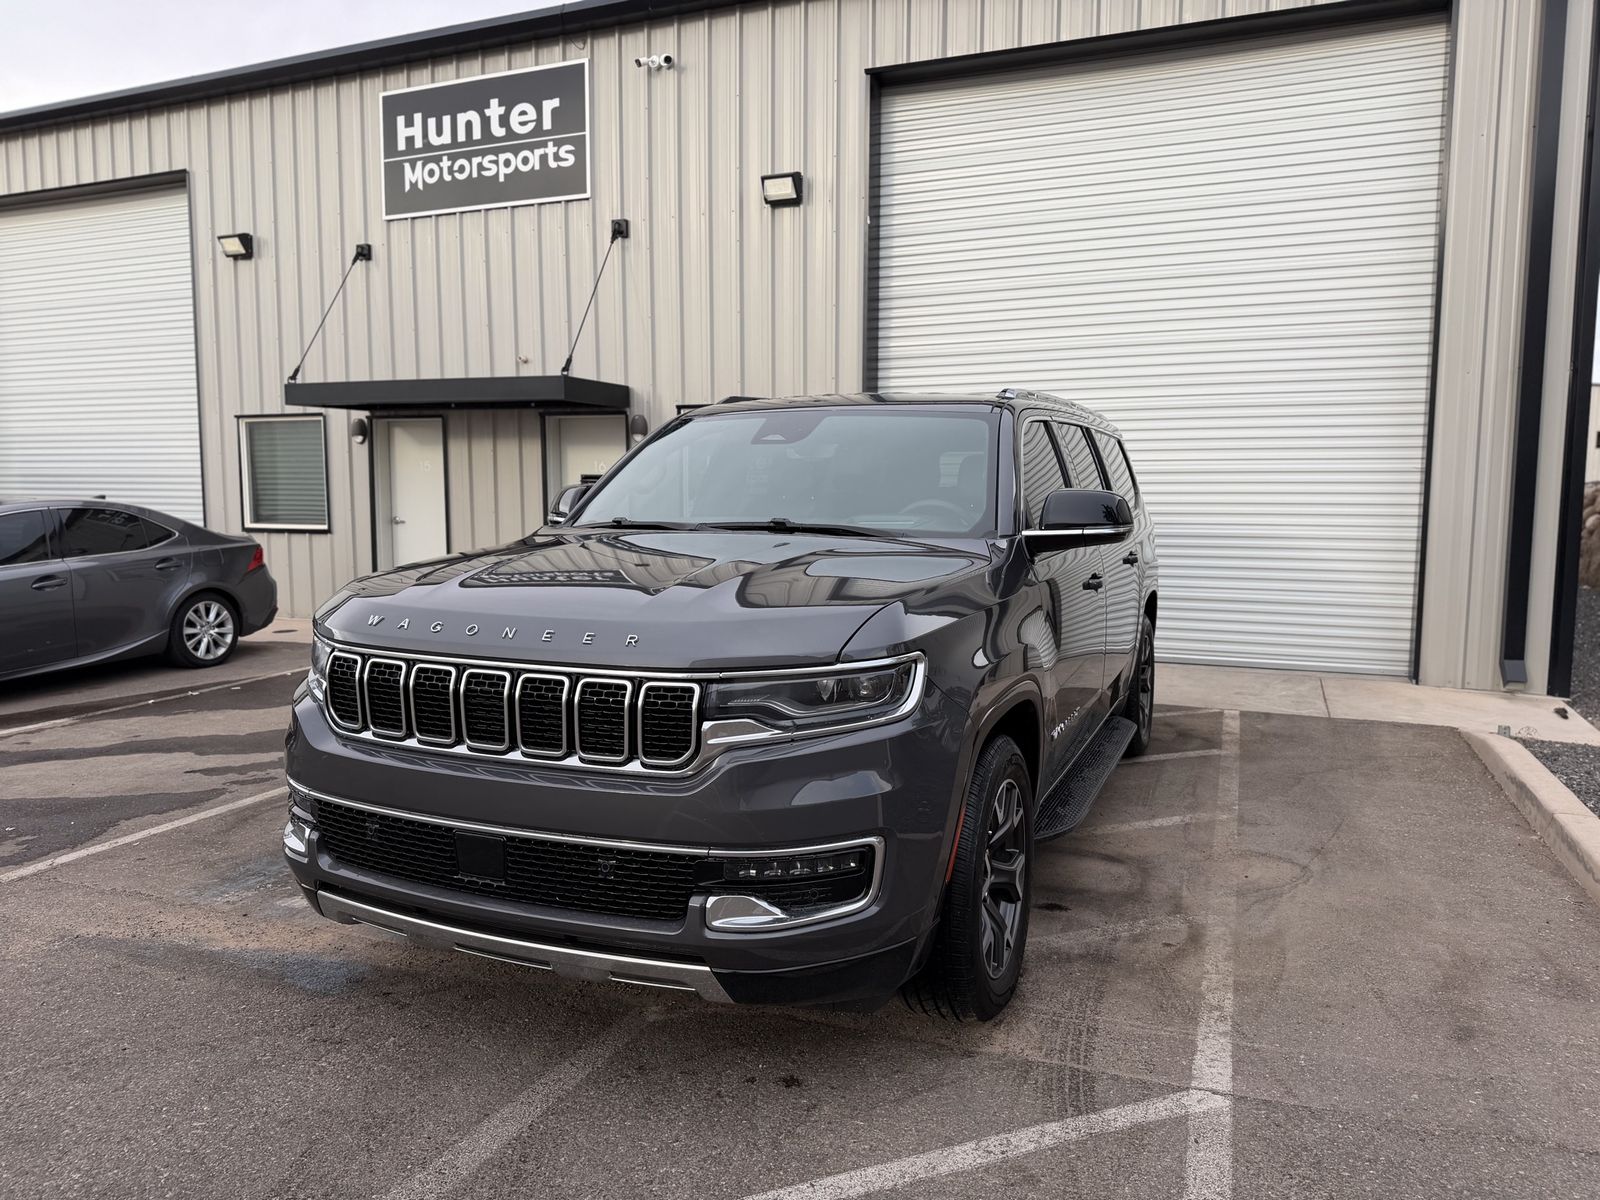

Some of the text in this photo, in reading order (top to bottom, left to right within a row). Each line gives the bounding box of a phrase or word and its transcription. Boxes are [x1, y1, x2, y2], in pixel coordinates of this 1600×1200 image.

[396, 97, 560, 151] Hunter
[403, 141, 576, 193] Motorsports
[418, 459, 432, 473] 15
[594, 459, 607, 475] 16
[367, 614, 640, 647] WAGONEER
